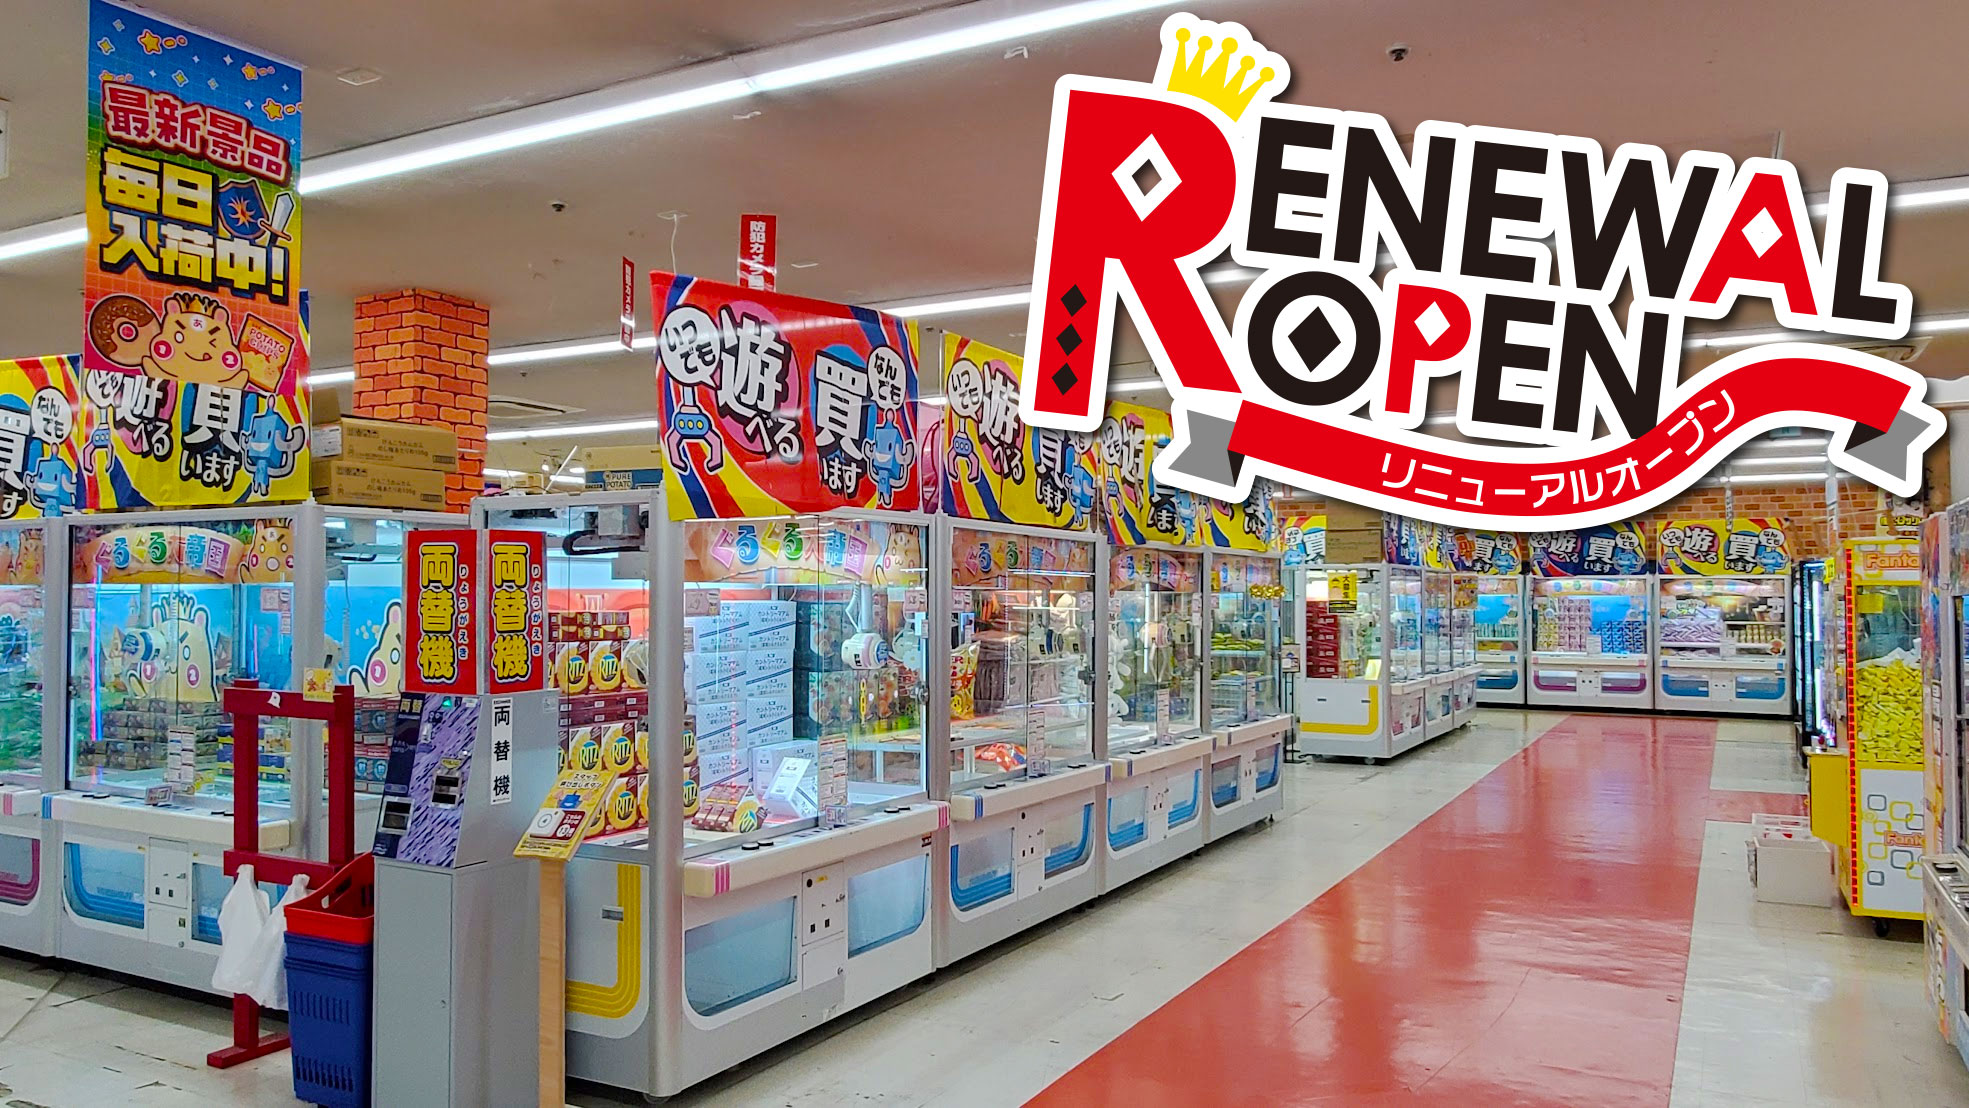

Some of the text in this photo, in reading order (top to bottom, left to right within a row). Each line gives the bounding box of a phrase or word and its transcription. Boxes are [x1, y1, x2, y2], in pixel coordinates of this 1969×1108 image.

[104, 83, 288, 179] 最新景品
[102, 148, 214, 226] 毎日
[250, 328, 286, 353] POTATO
[665, 320, 698, 352] いつ
[680, 342, 716, 373] でも
[874, 352, 898, 380] なん
[878, 379, 902, 405] でも
[951, 370, 972, 394] いつ
[37, 395, 60, 418] なん
[43, 417, 64, 439] でも
[181, 451, 240, 487] います
[611, 473, 631, 481] PURE
[606, 480, 632, 488] POTATO
[94, 531, 232, 579] ぐるぐる大帝国
[710, 521, 869, 577] ぐるぐる大帝国
[419, 543, 457, 681] 両替機
[459, 564, 469, 659] りょうがえき
[492, 543, 528, 681] 両替機
[532, 564, 541, 657] りょうがえき
[600, 658, 618, 681] RITZ
[492, 706, 511, 797] 両替機
[581, 746, 599, 768] RITZ
[612, 740, 632, 763] RITZ
[617, 795, 635, 818] RITZ
